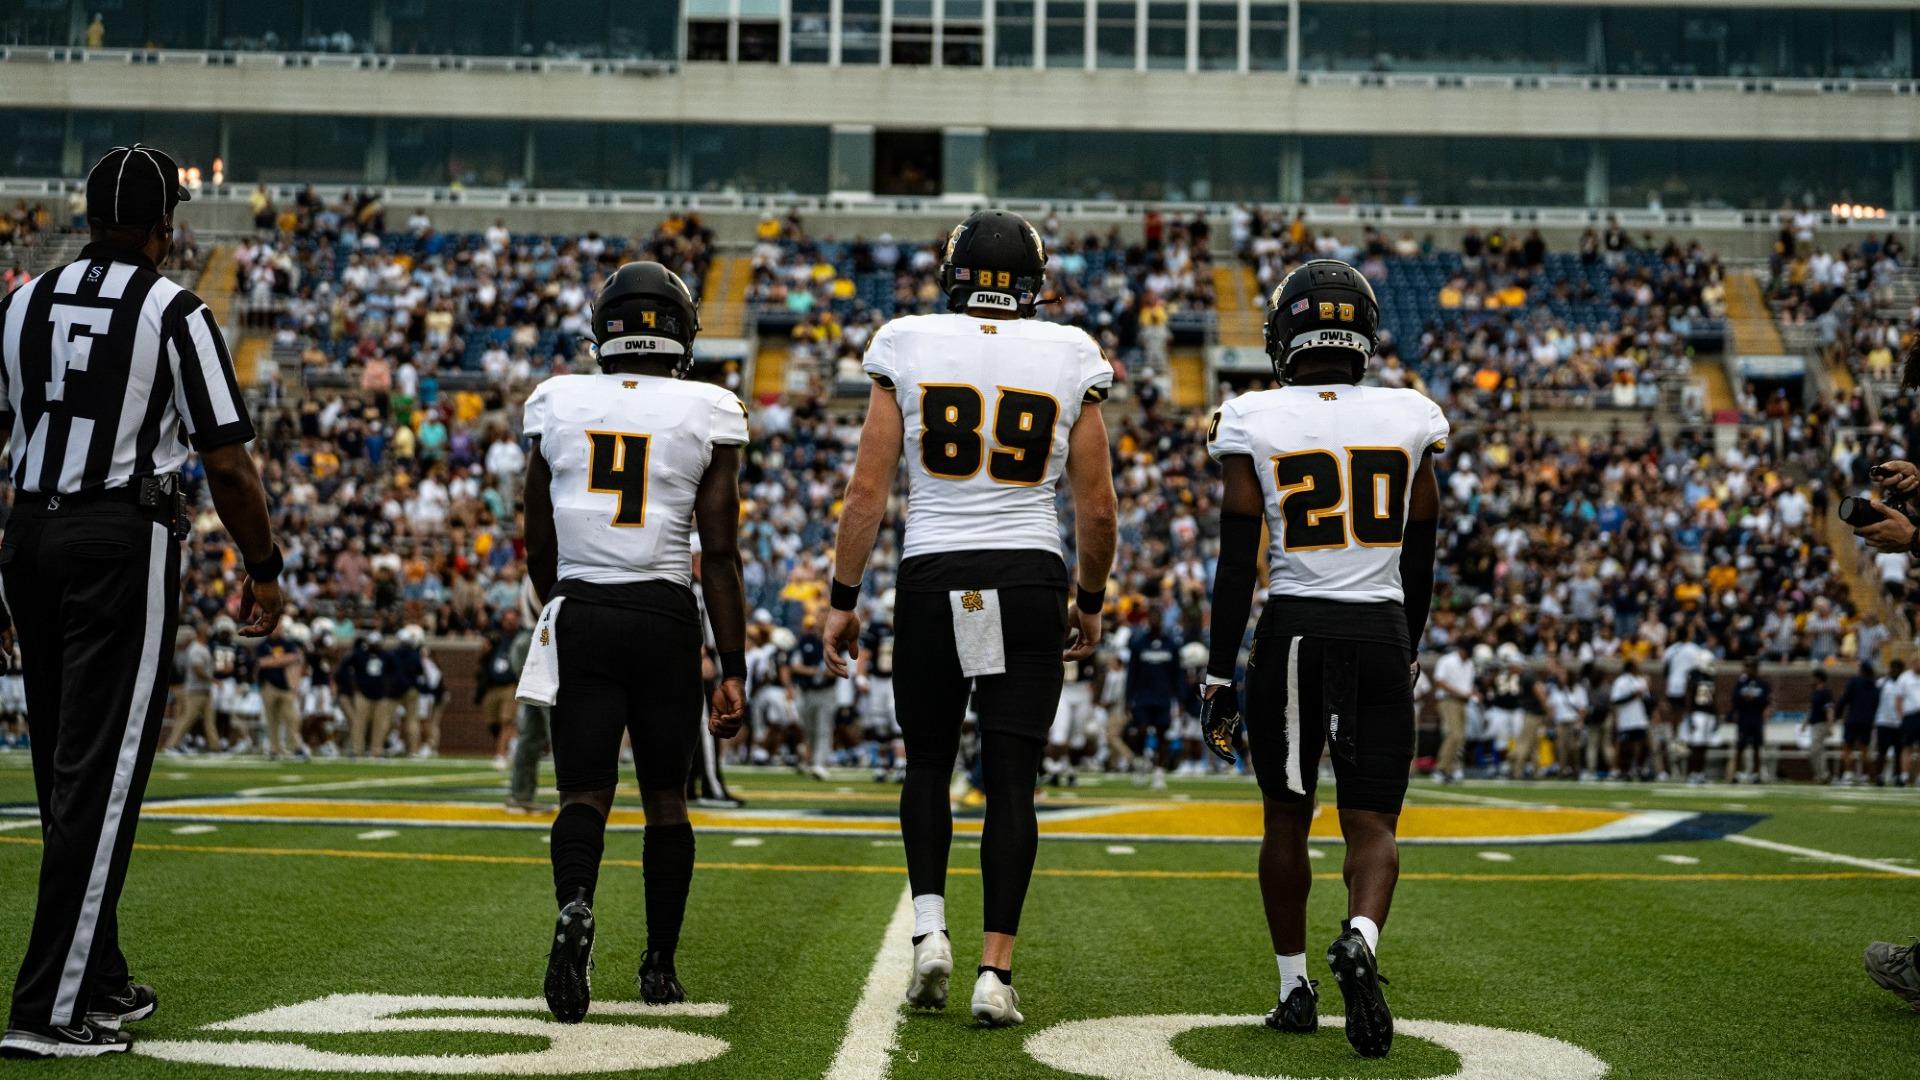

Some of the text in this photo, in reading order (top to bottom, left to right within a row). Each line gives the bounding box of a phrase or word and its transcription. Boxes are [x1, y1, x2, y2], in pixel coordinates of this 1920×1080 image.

[978, 269, 1011, 288] 89
[976, 293, 1011, 306] OWLS
[642, 311, 656, 328] 4
[1318, 302, 1354, 322] 20
[625, 340, 656, 350] OWLS
[1320, 331, 1353, 342] OWLS
[45, 304, 113, 401] F
[918, 383, 1060, 487] 89
[585, 430, 652, 528] 4
[1270, 446, 1412, 552] 20
[133, 992, 732, 1075] 5
